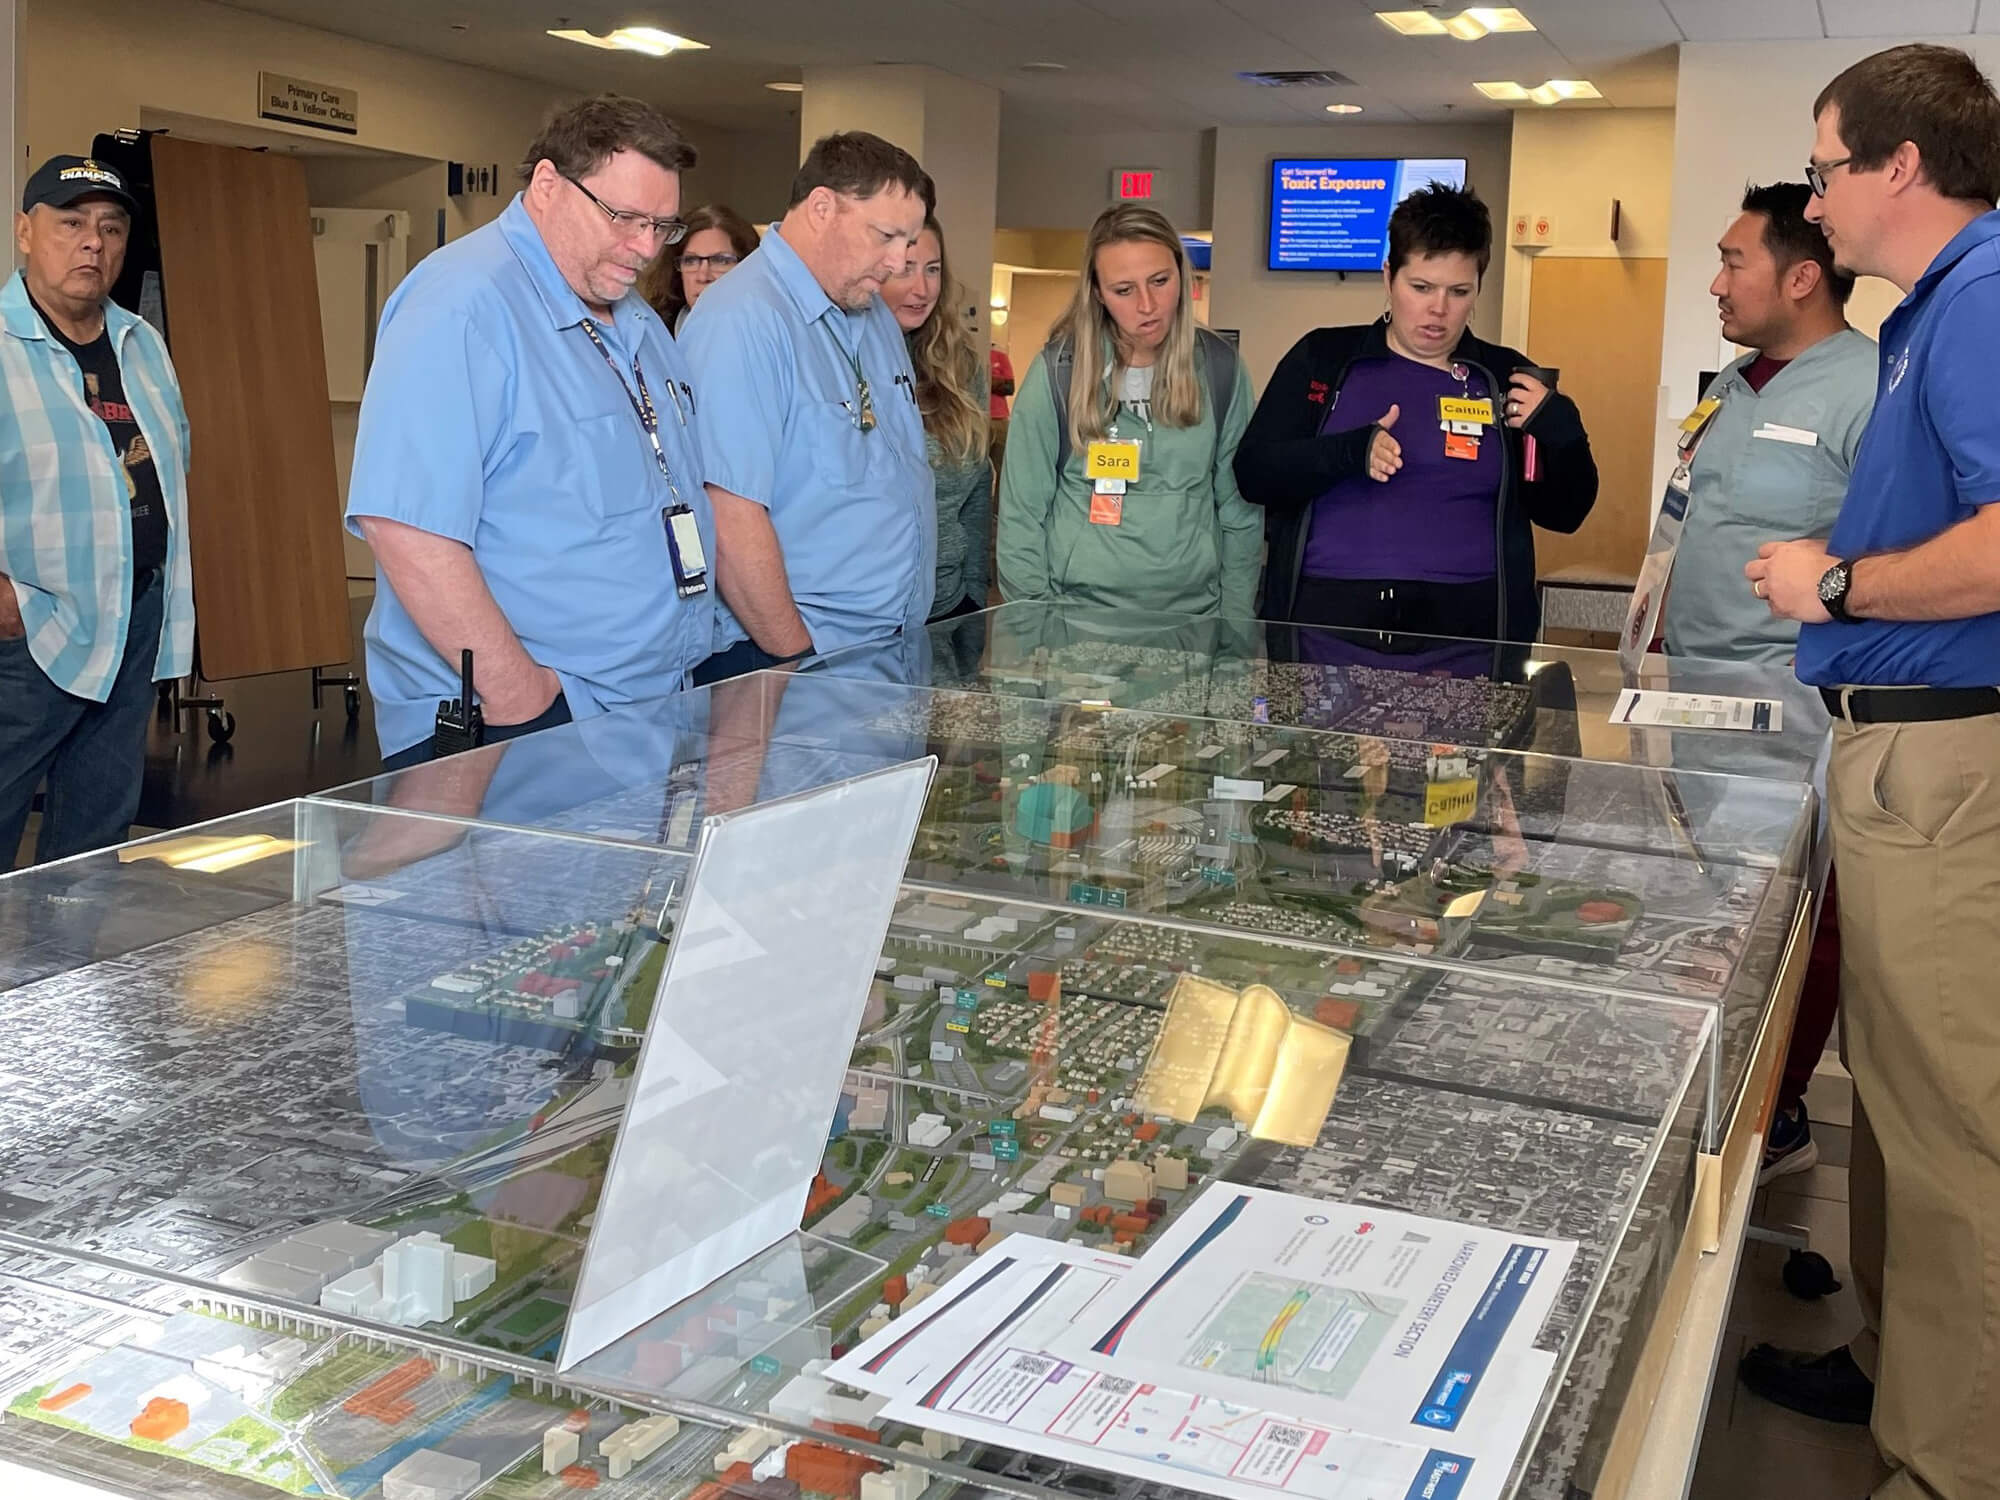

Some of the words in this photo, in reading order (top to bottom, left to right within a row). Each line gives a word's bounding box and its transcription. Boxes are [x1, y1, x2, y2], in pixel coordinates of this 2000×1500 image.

[287, 84, 318, 102] Primary
[321, 91, 339, 105] Care
[271, 95, 289, 110] Blue
[292, 100, 299, 111] &
[302, 102, 326, 116] Yellow
[1281, 167, 1294, 176] Get
[1121, 171, 1153, 200] EXIT
[1281, 176, 1318, 190] Toxic
[1319, 176, 1386, 193] Exposure
[1444, 404, 1490, 417] Caitlin
[1097, 454, 1131, 468] Sara
[1441, 1239, 1480, 1283] NARROWED
[1416, 1282, 1453, 1322] CEMETERY
[1392, 1320, 1429, 1359] SECTION
